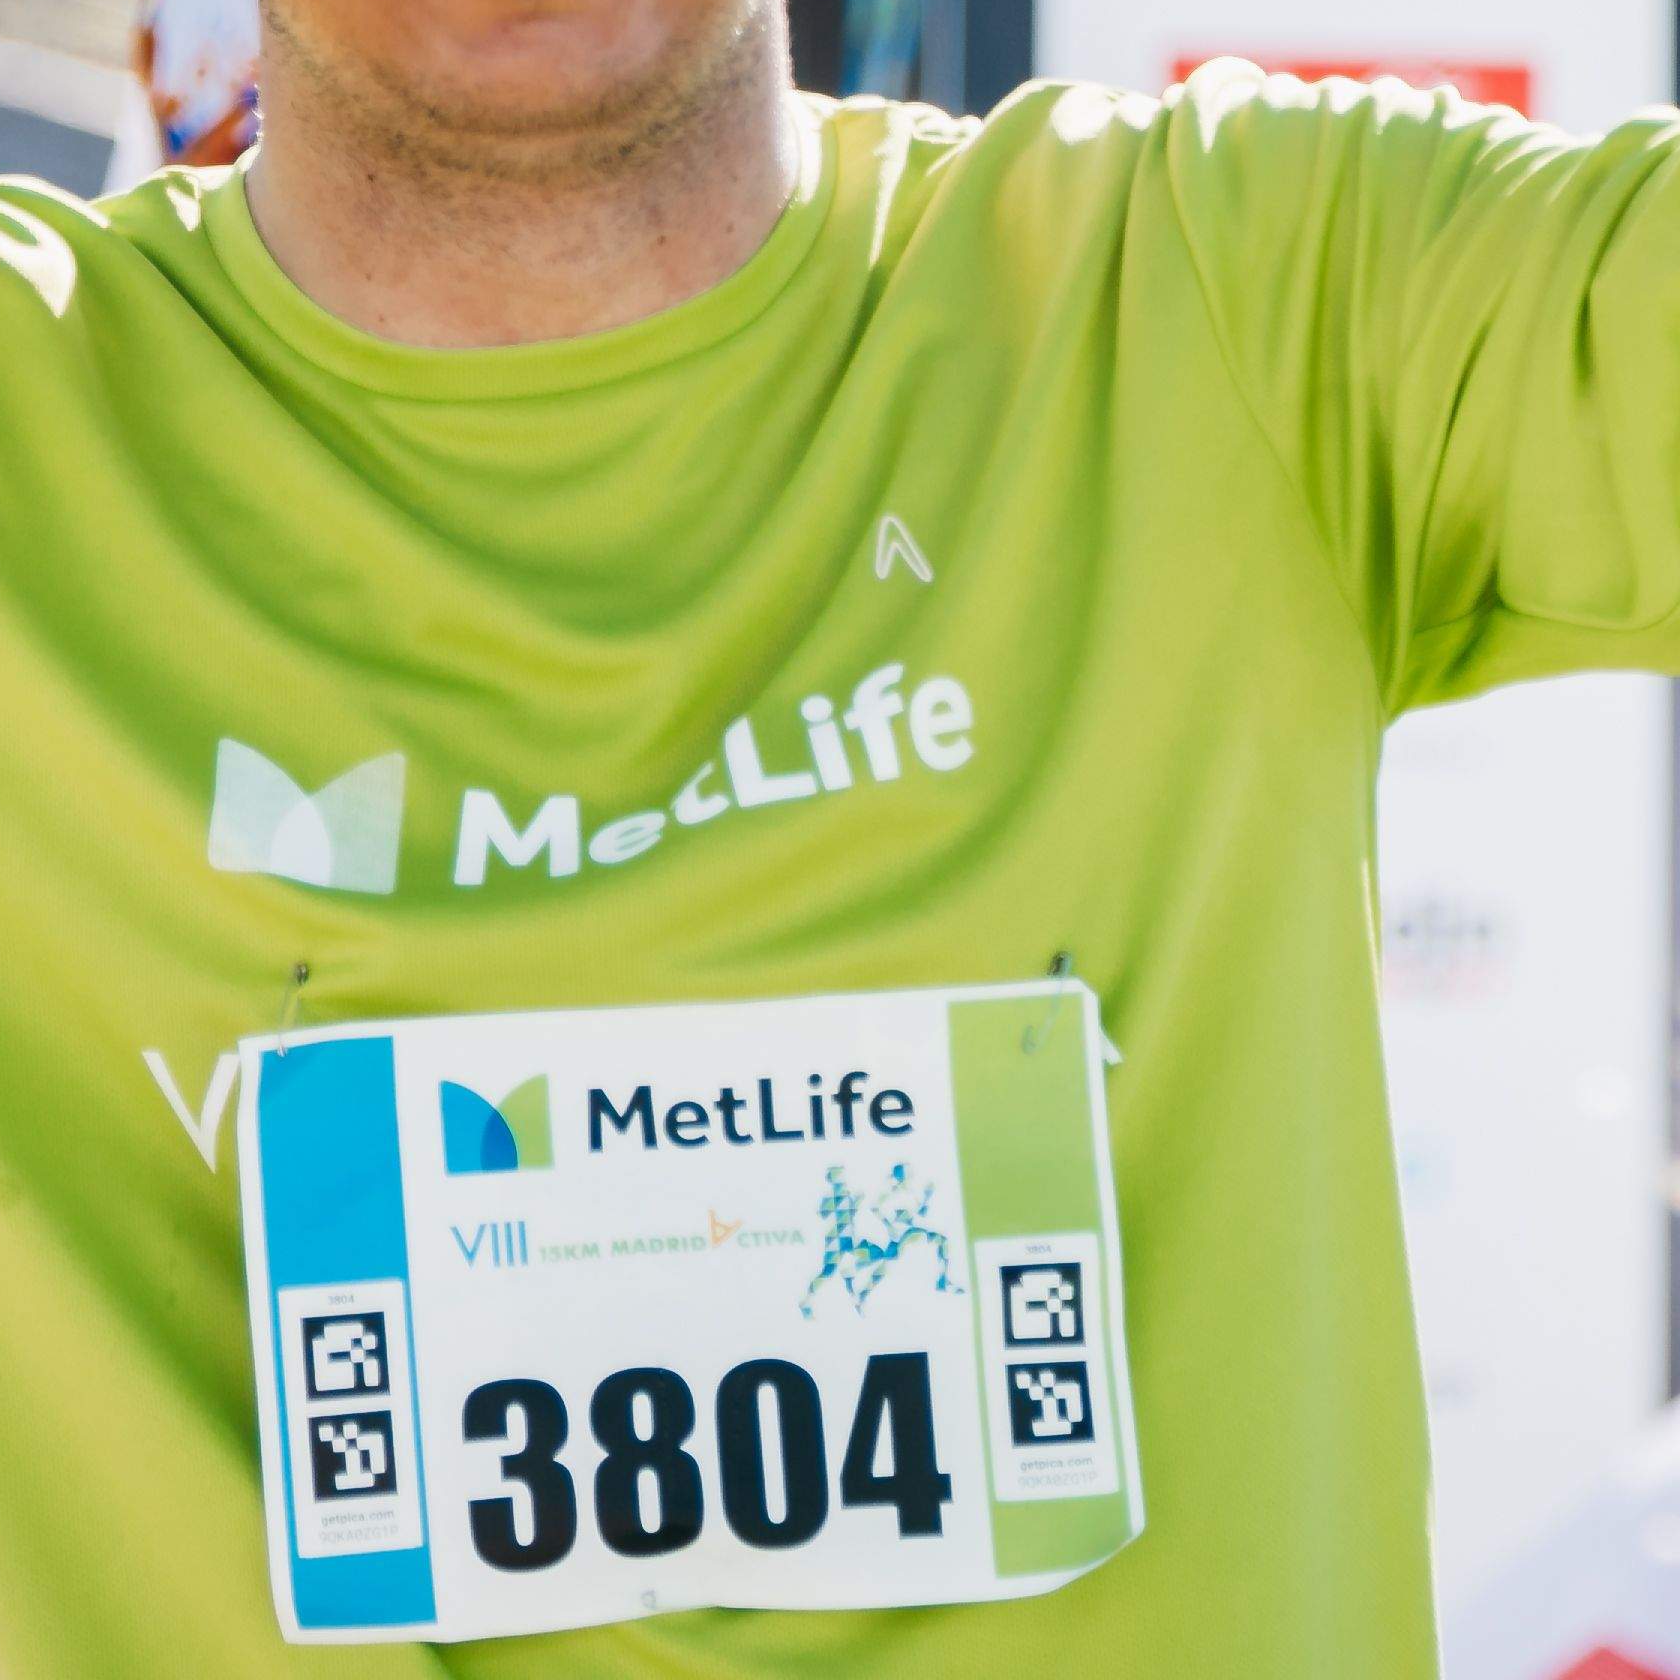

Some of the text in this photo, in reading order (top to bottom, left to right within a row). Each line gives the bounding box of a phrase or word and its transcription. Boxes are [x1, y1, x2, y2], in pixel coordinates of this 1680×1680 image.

[452, 662, 975, 888] MetLife
[587, 1071, 916, 1153] MetLife
[450, 1219, 529, 1269] VIII
[461, 1351, 953, 1574] 3804
